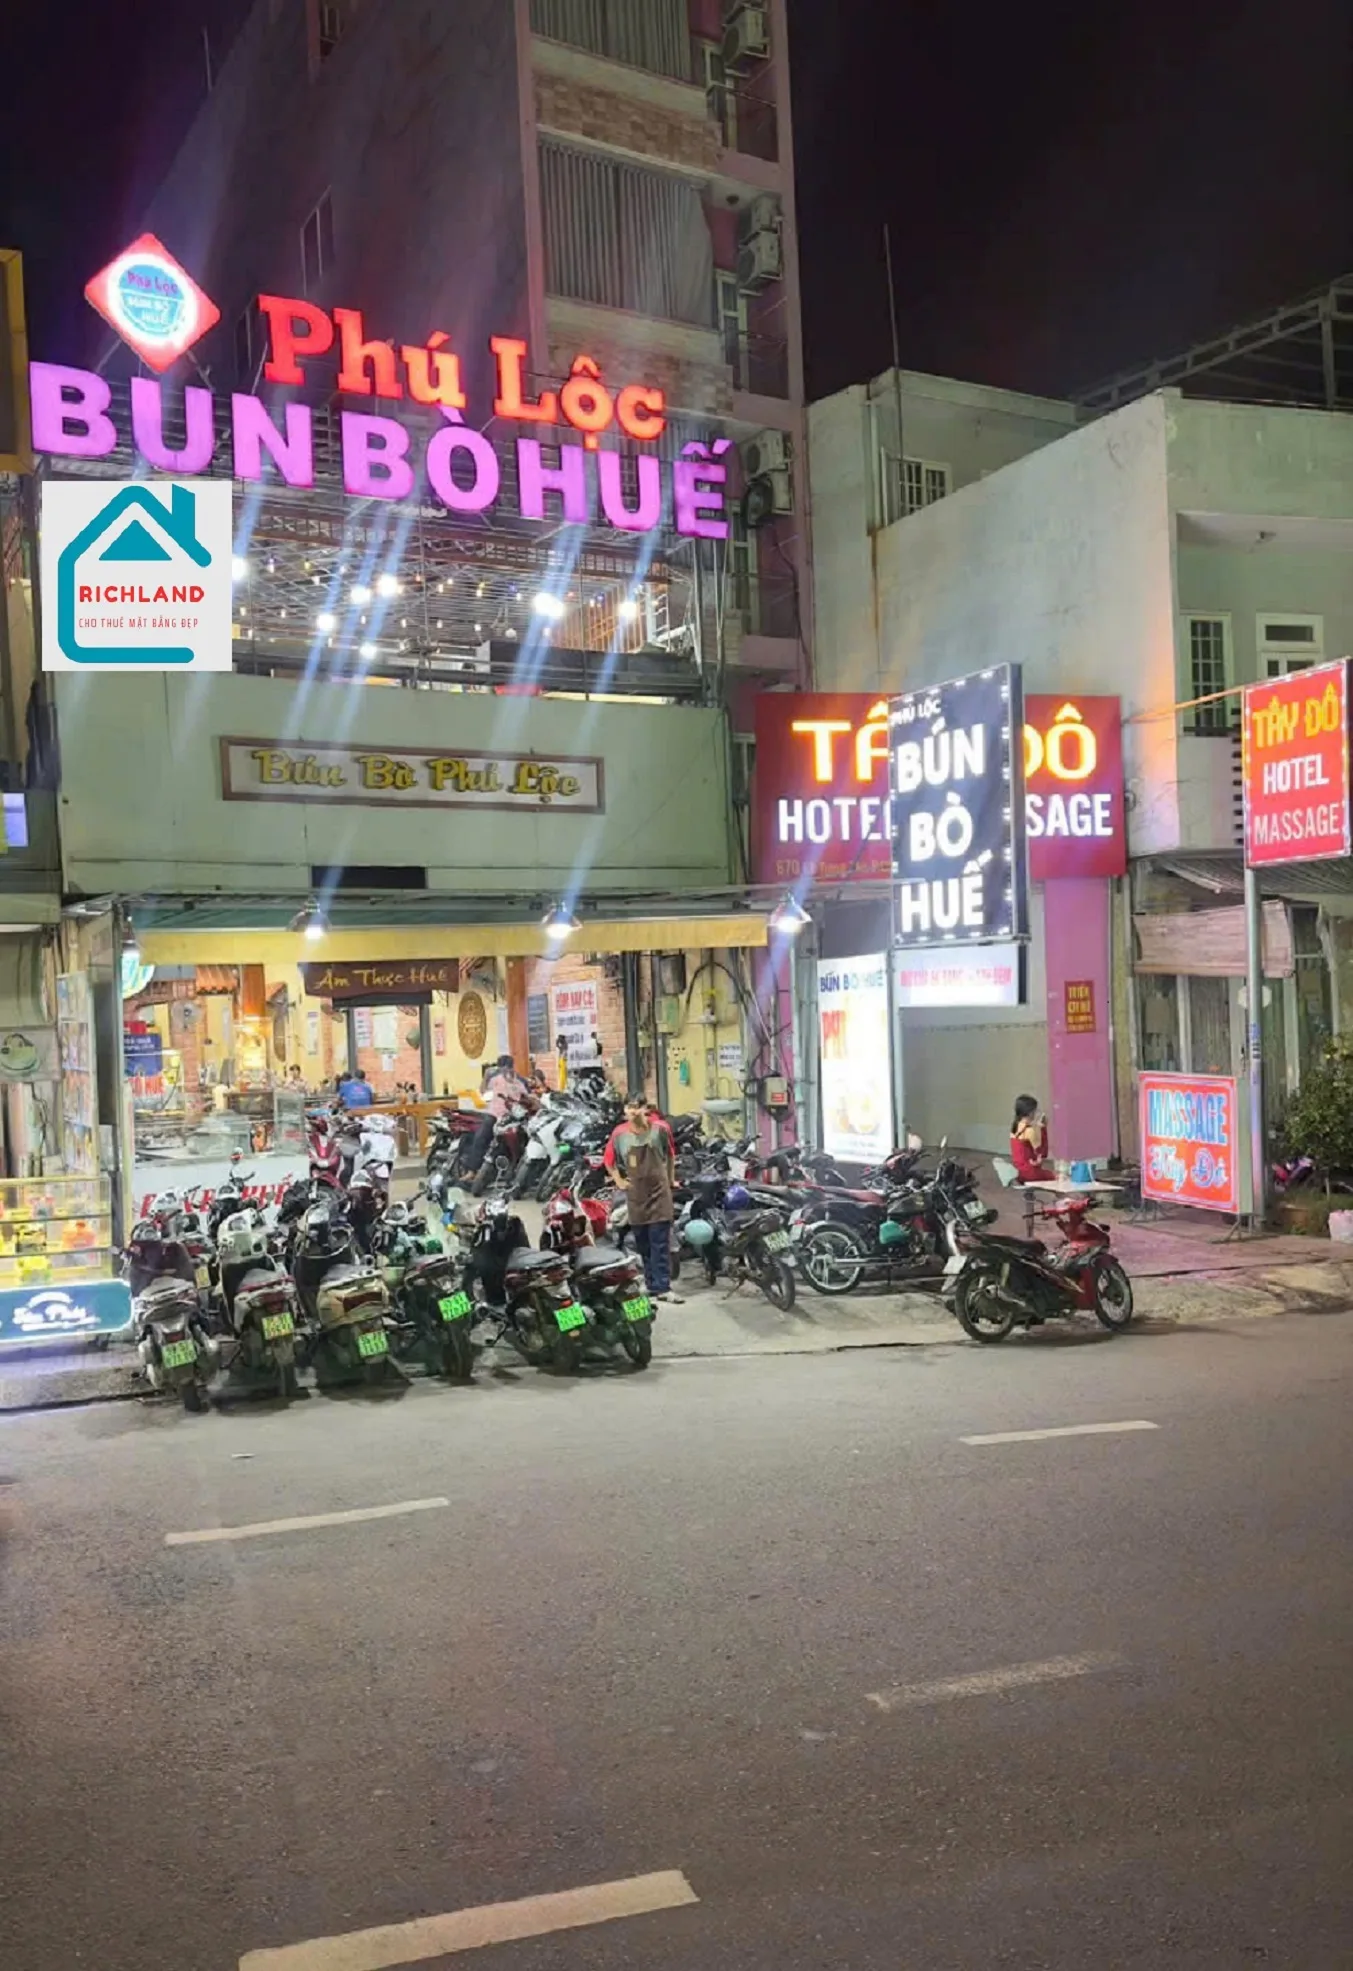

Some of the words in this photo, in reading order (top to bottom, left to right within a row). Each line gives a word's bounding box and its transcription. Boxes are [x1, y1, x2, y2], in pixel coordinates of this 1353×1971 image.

[258, 293, 467, 408] Phú
[490, 335, 667, 451] Lộc
[341, 403, 500, 512] BÒ
[517, 438, 735, 539] HUẾ
[791, 699, 889, 783] TÂ
[1252, 695, 1300, 748] TÂY
[1304, 681, 1340, 738] ĐÔ
[252, 750, 348, 787] Bún
[355, 754, 419, 790] Bò
[422, 757, 504, 793] Phú
[508, 762, 582, 803] Lộc
[897, 716, 986, 793] BÚN
[1262, 753, 1330, 796] HOTEL
[909, 791, 974, 862] BÒ
[1254, 802, 1341, 846] MASSAGE
[900, 849, 994, 933] HUẾ
[1147, 1088, 1228, 1147] MASSAGE
